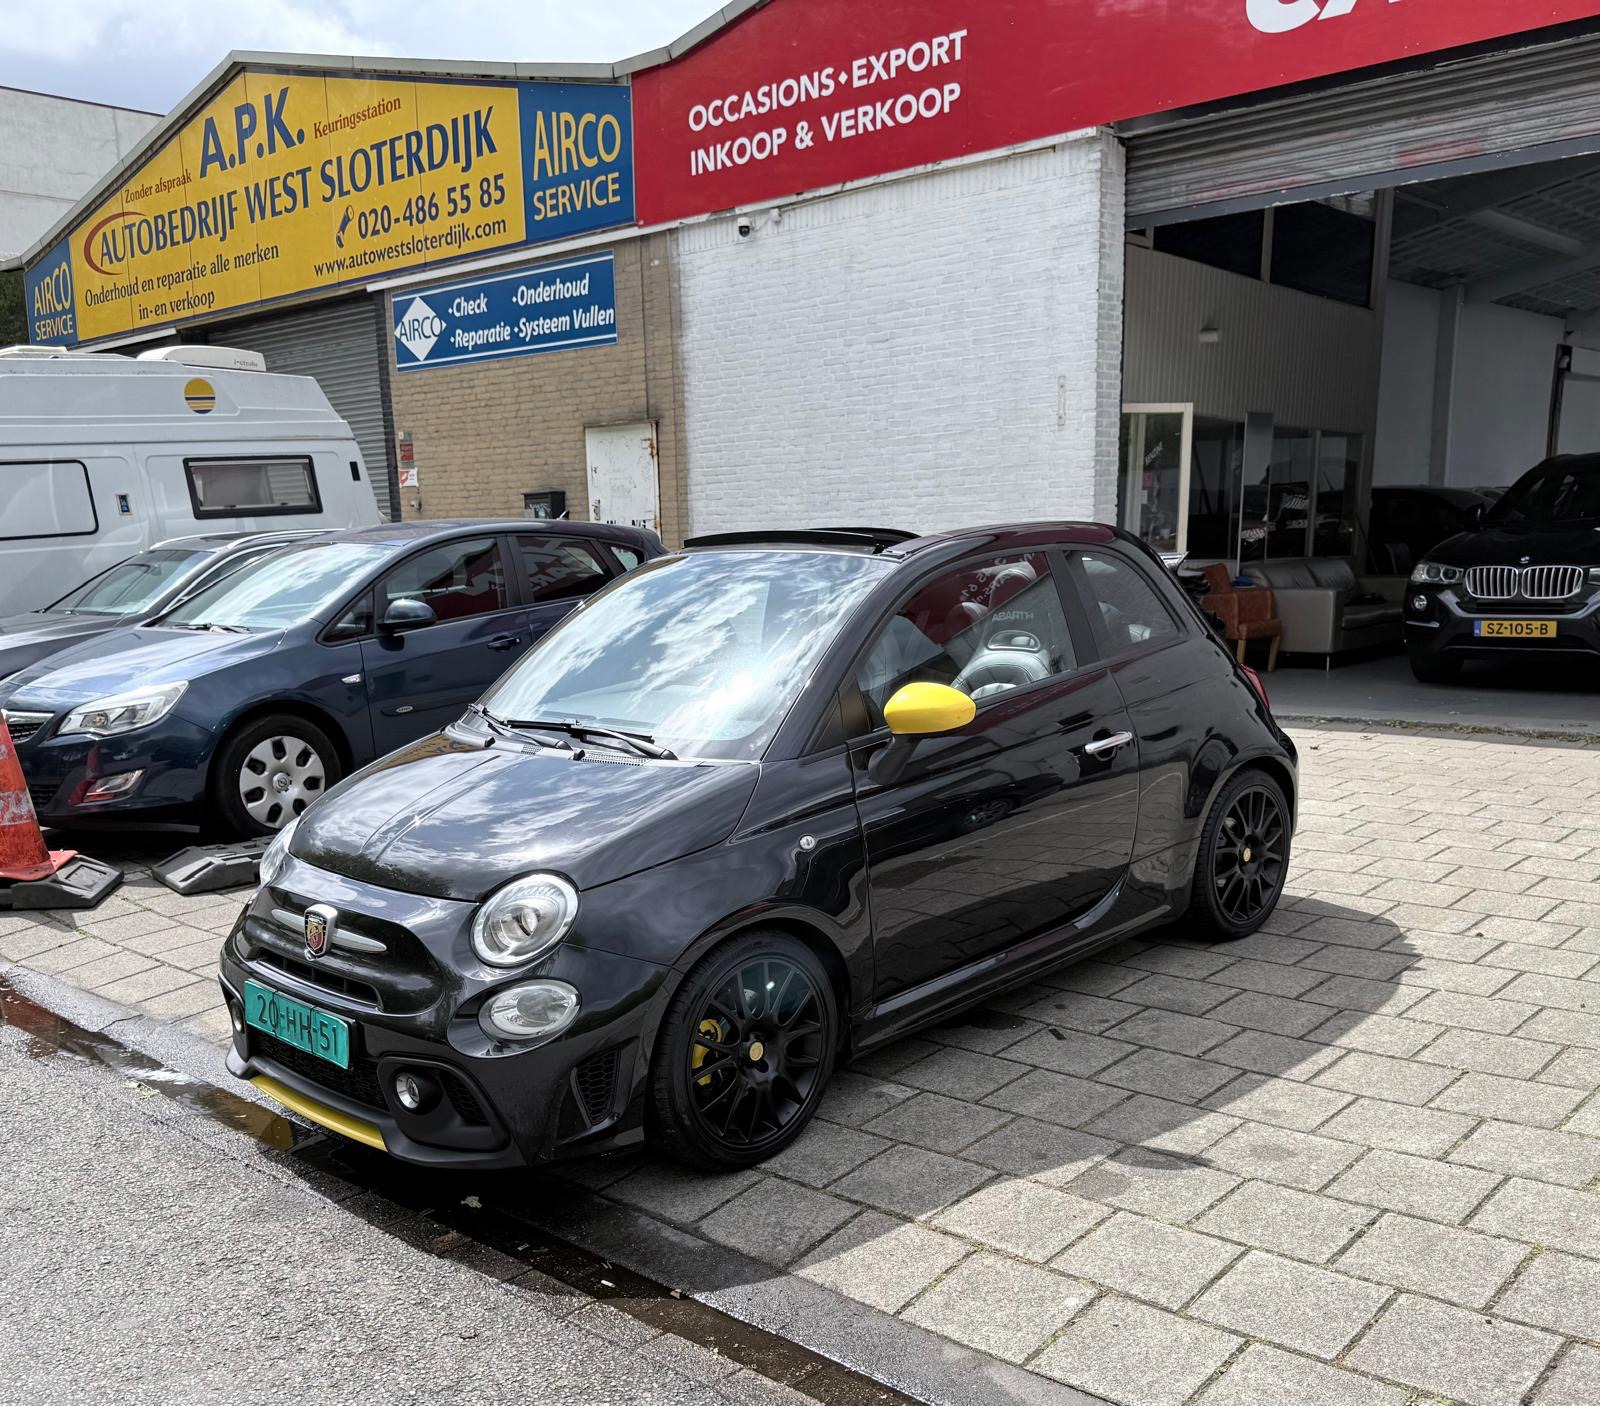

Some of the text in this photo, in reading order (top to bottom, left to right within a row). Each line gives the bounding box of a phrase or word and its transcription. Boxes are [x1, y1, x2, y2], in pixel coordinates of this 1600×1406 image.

[688, 29, 967, 132] OCCASIONS EXPORT
[199, 86, 305, 178] A.P.K.
[313, 97, 401, 139] Keuringsstation
[533, 111, 621, 181] AIRCO
[690, 82, 961, 176] INKOOP & VERKOOP
[100, 105, 497, 267] AUTOBEDRIJF WEST SLOTERDIJK
[125, 169, 192, 204] Zonder afspraak
[358, 173, 506, 239] 020-486 55 85
[534, 172, 620, 221] SERVICE
[85, 244, 279, 307] Onderhoud en reparatie alle merken
[314, 218, 506, 277] www.autowestsloterdijk.com
[34, 261, 72, 317] AIRCO
[169, 290, 215, 315] verkoop
[453, 273, 589, 317] Check Onderhoud
[35, 316, 73, 341] SERVICE
[399, 316, 441, 343] AIRCO
[455, 305, 614, 350] Reparatie Systeem Vullen
[1487, 623, 1548, 635] SZ-105-B
[256, 993, 338, 1057] 20-HH-51
